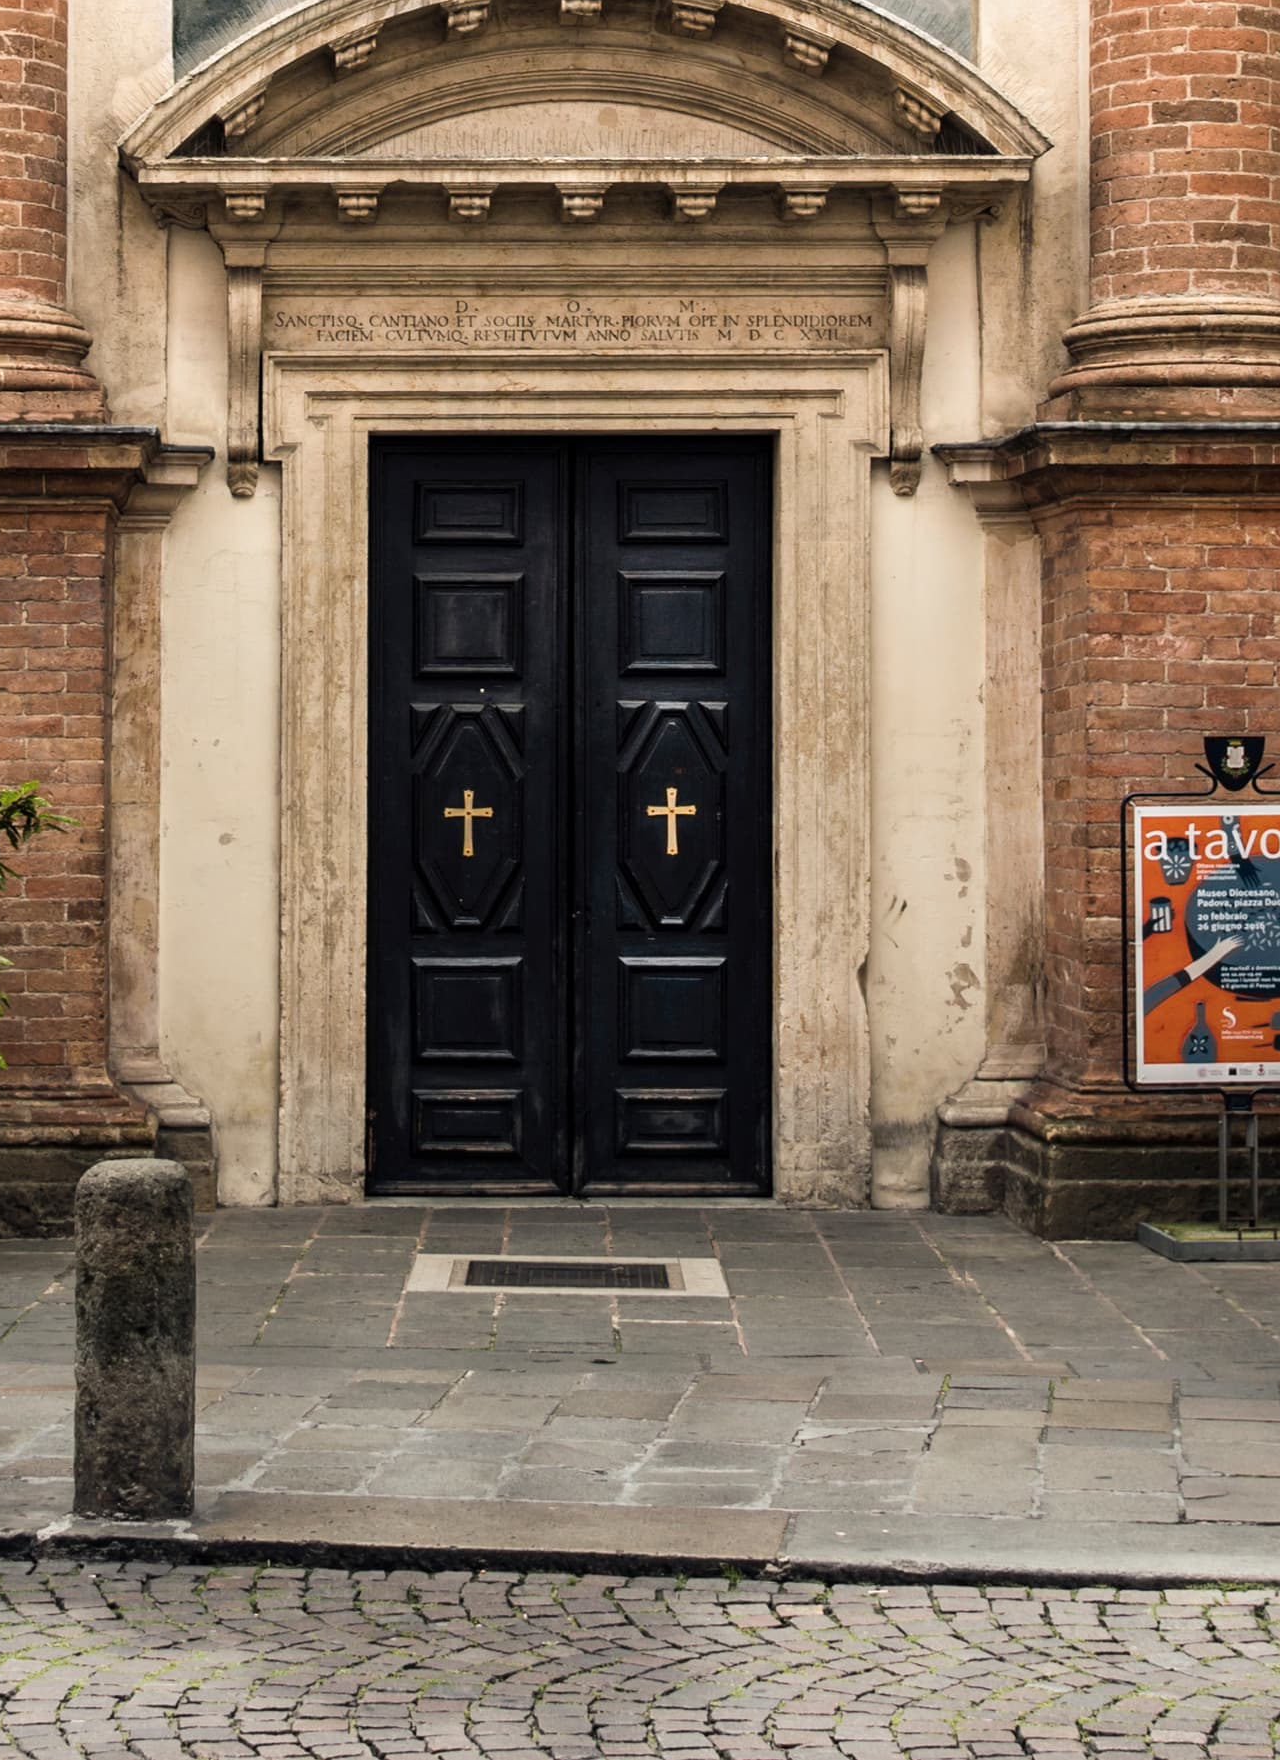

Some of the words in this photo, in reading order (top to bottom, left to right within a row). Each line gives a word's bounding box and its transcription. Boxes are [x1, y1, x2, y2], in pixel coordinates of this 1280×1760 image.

[370, 315, 449, 328] CANTIANO
[457, 315, 477, 328] ET
[689, 315, 718, 328] OPE
[723, 315, 740, 328] IN
[586, 329, 631, 342] ANNO
[1144, 830, 1170, 861] a
[1197, 889, 1227, 897] Museo
[1197, 898, 1232, 908] Padova,
[1234, 898, 1263, 908] piazza
[1197, 913, 1209, 921] 20
[1210, 911, 1249, 921] febbraio
[1197, 922, 1209, 931] 26
[1210, 921, 1242, 932] giugno
